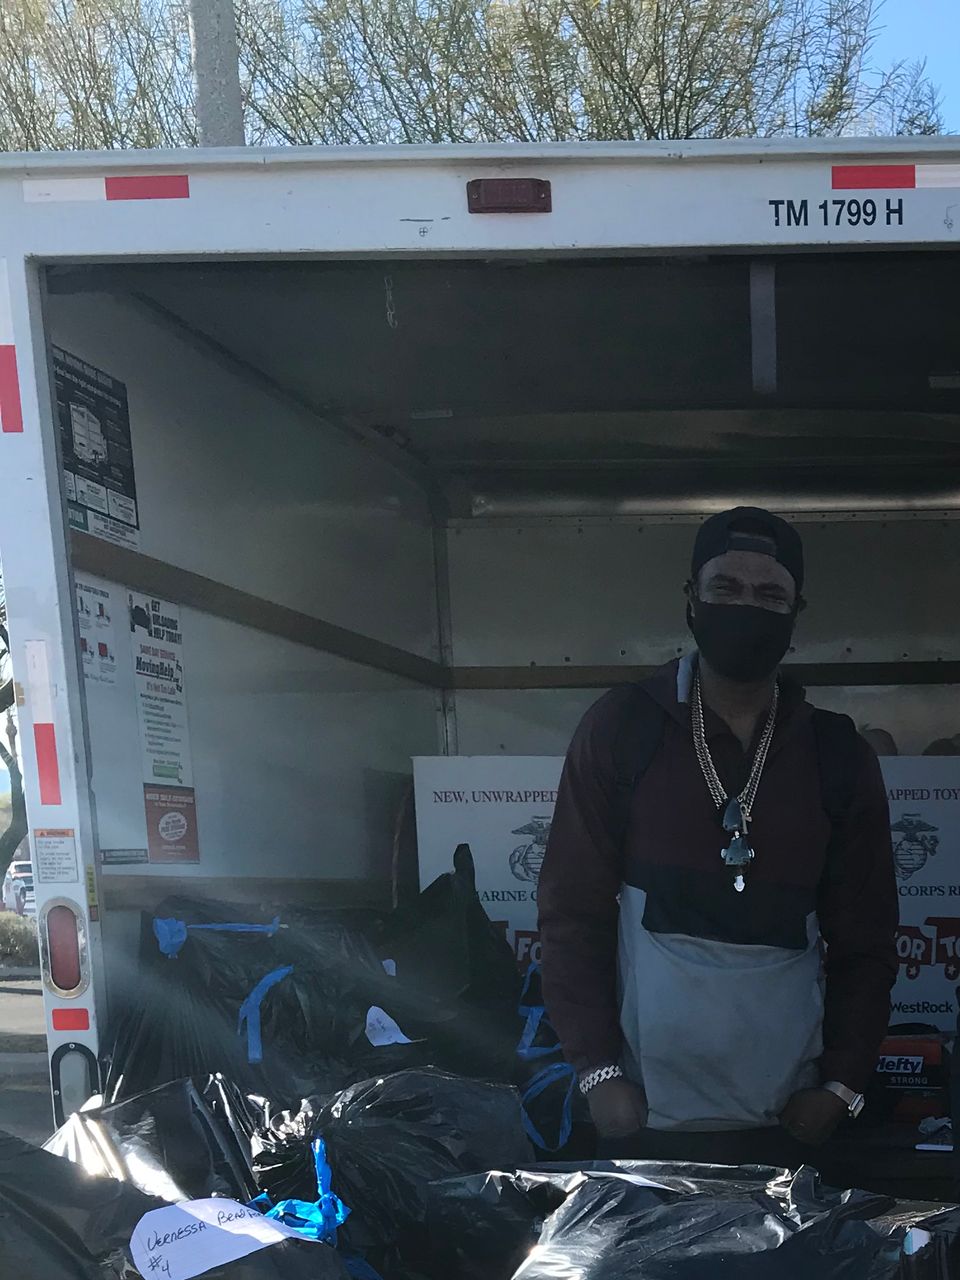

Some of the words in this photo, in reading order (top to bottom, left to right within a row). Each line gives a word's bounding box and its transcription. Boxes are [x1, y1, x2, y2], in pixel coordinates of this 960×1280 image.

[768, 199, 809, 227] TM
[818, 198, 877, 227] 1799
[885, 198, 904, 226] H
[432, 790, 469, 804] NEW,
[471, 790, 559, 803] UNWRAPPED
[888, 788, 930, 801] APPED
[477, 890, 527, 902] ARINE
[898, 885, 945, 897] CORPS
[516, 937, 541, 966] FO
[894, 933, 926, 961] OR
[890, 1001, 953, 1014] WestRock
[890, 1076, 928, 1085] STRONG
